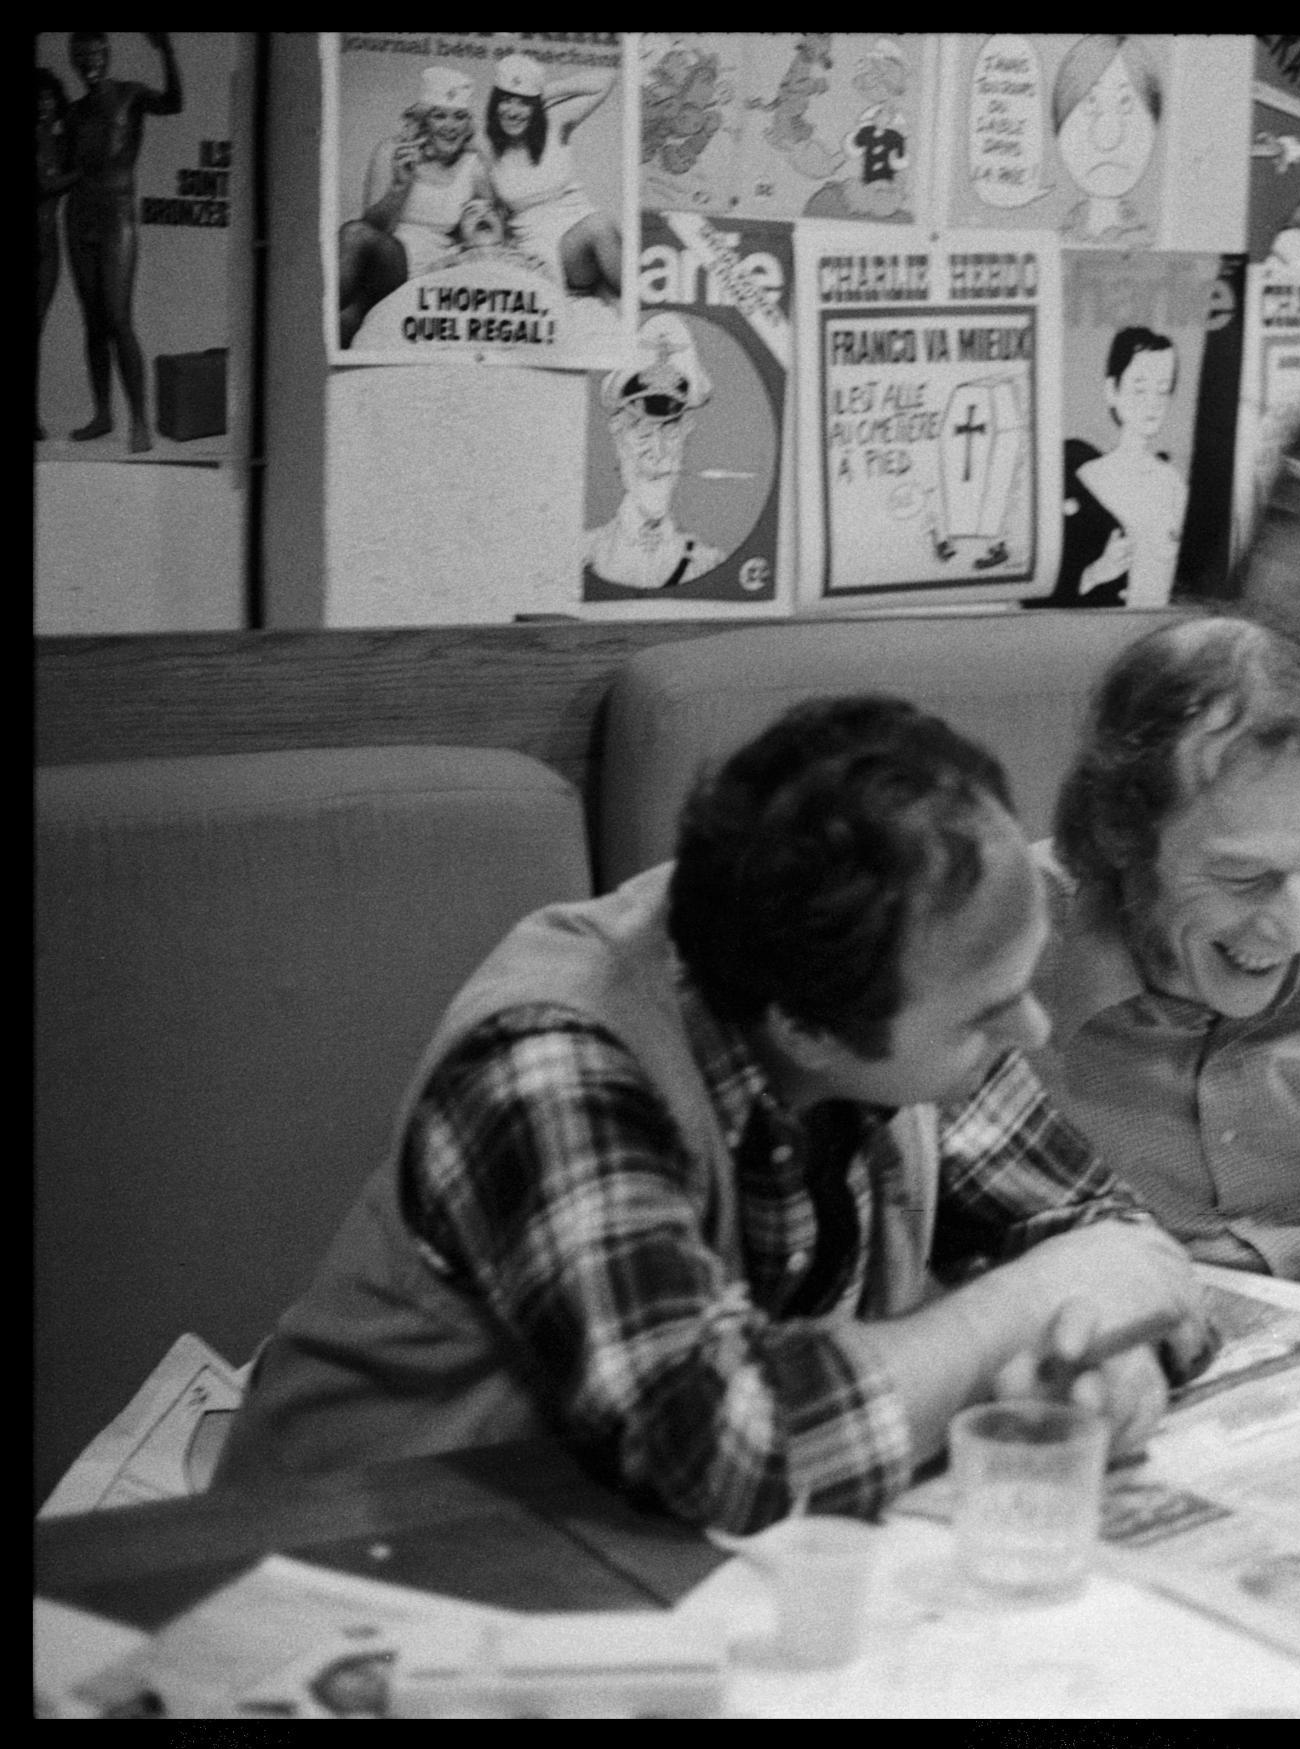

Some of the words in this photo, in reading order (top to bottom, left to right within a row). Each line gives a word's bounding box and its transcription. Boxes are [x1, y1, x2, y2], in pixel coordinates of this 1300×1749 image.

[820, 255, 930, 302] CHARLIE
[948, 252, 1037, 300] HEBDO
[417, 286, 550, 317] L'HOPITAL,
[403, 316, 461, 343] QUEL
[466, 318, 556, 345] REGAL!
[831, 329, 916, 365] FRANCO
[922, 328, 950, 362] VA
[957, 327, 1034, 362] MIEUX
